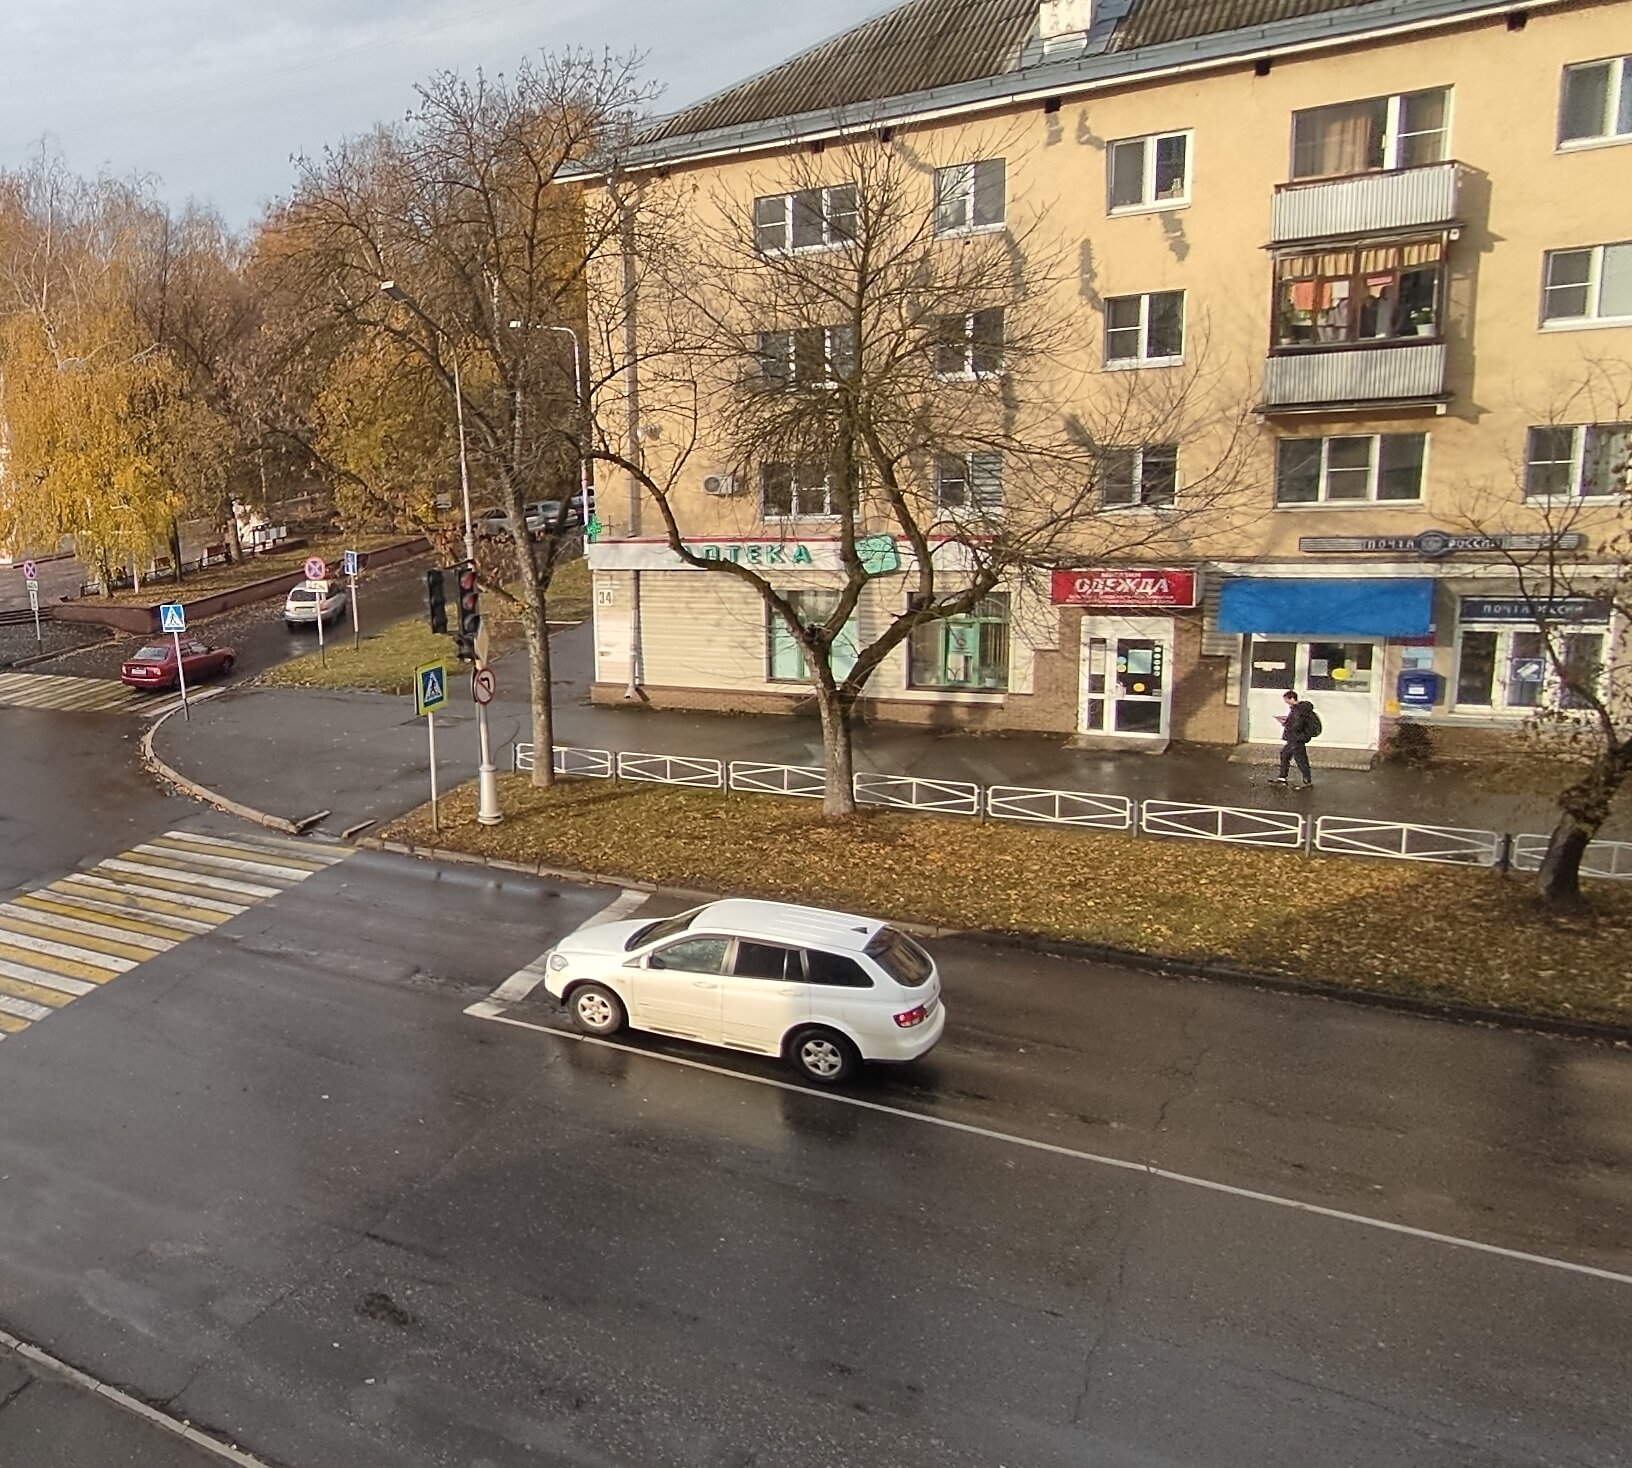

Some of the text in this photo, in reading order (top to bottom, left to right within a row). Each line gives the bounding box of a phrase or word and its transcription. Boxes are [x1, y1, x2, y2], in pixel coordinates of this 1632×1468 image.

[1367, 539, 1415, 550] ПОЧТА
[1074, 578, 1170, 595] ОДЕЖДА
[599, 591, 612, 604] 34
